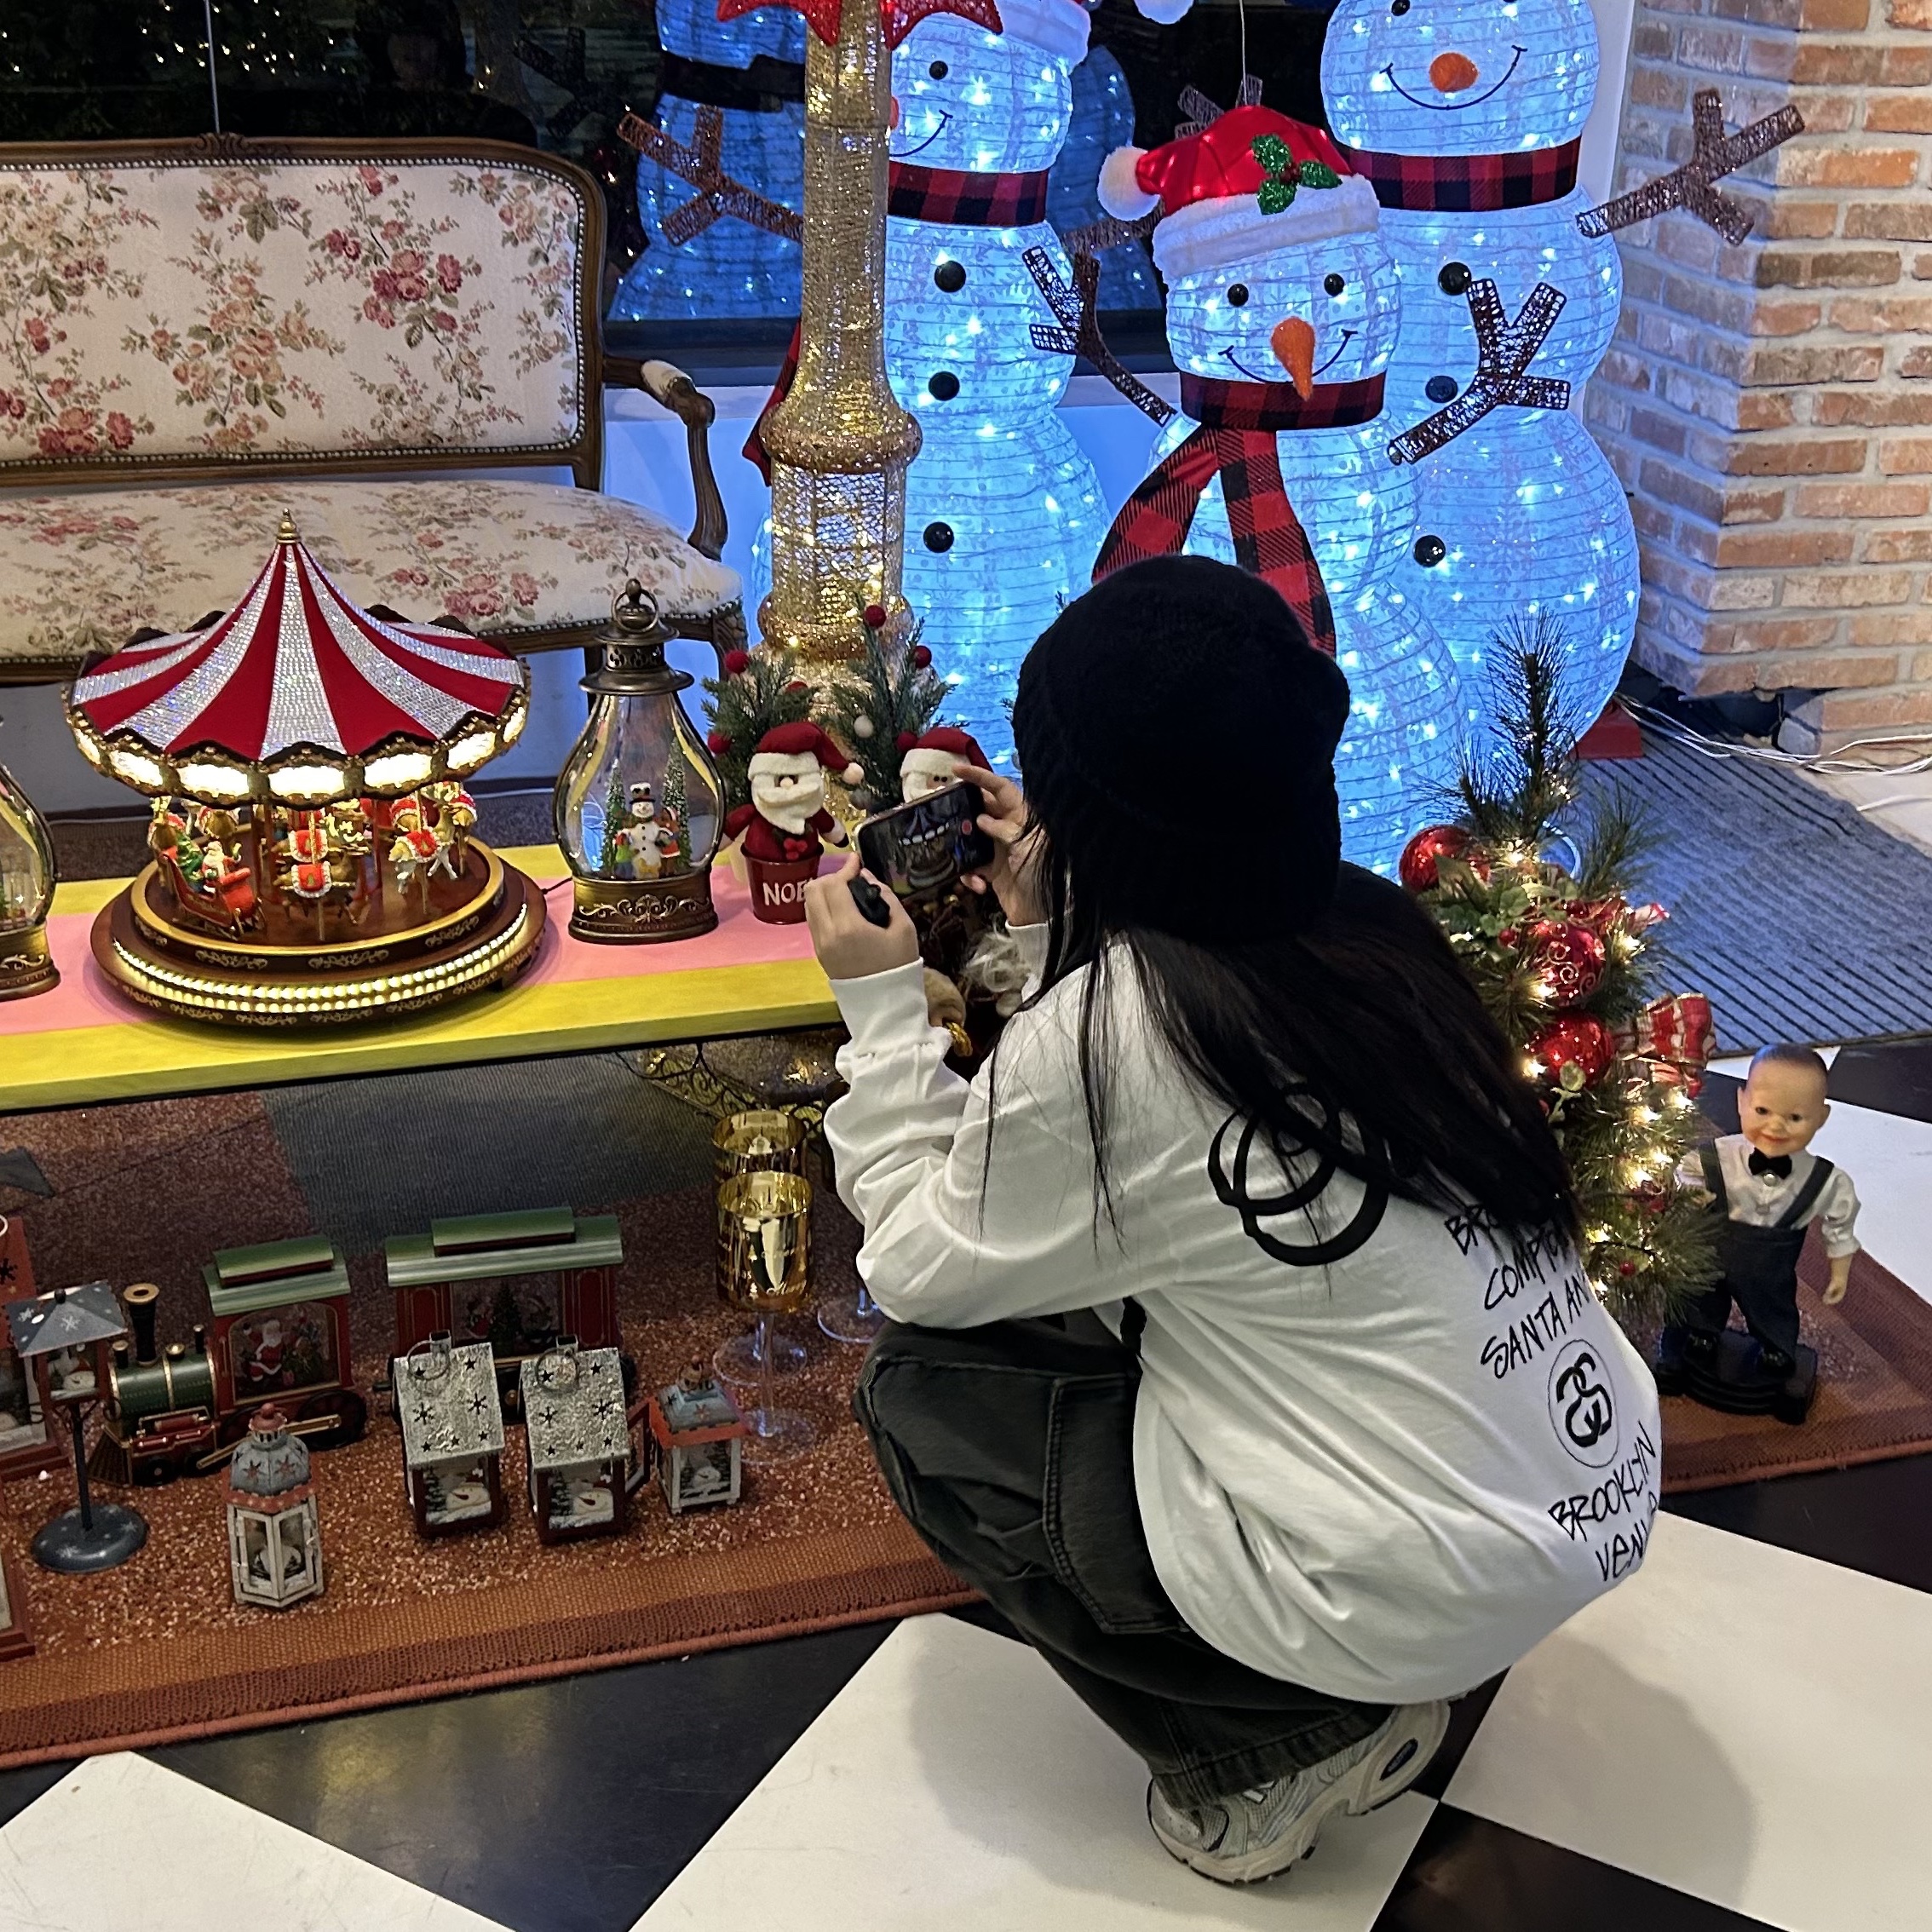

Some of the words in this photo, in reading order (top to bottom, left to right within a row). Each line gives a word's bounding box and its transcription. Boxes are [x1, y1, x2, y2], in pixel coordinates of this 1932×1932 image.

[762, 878, 813, 906] NOE
[1481, 1291, 1567, 1378] SANTA
[1564, 1269, 1590, 1324] AN
[1548, 1420, 1656, 1542] BROOKLYN
